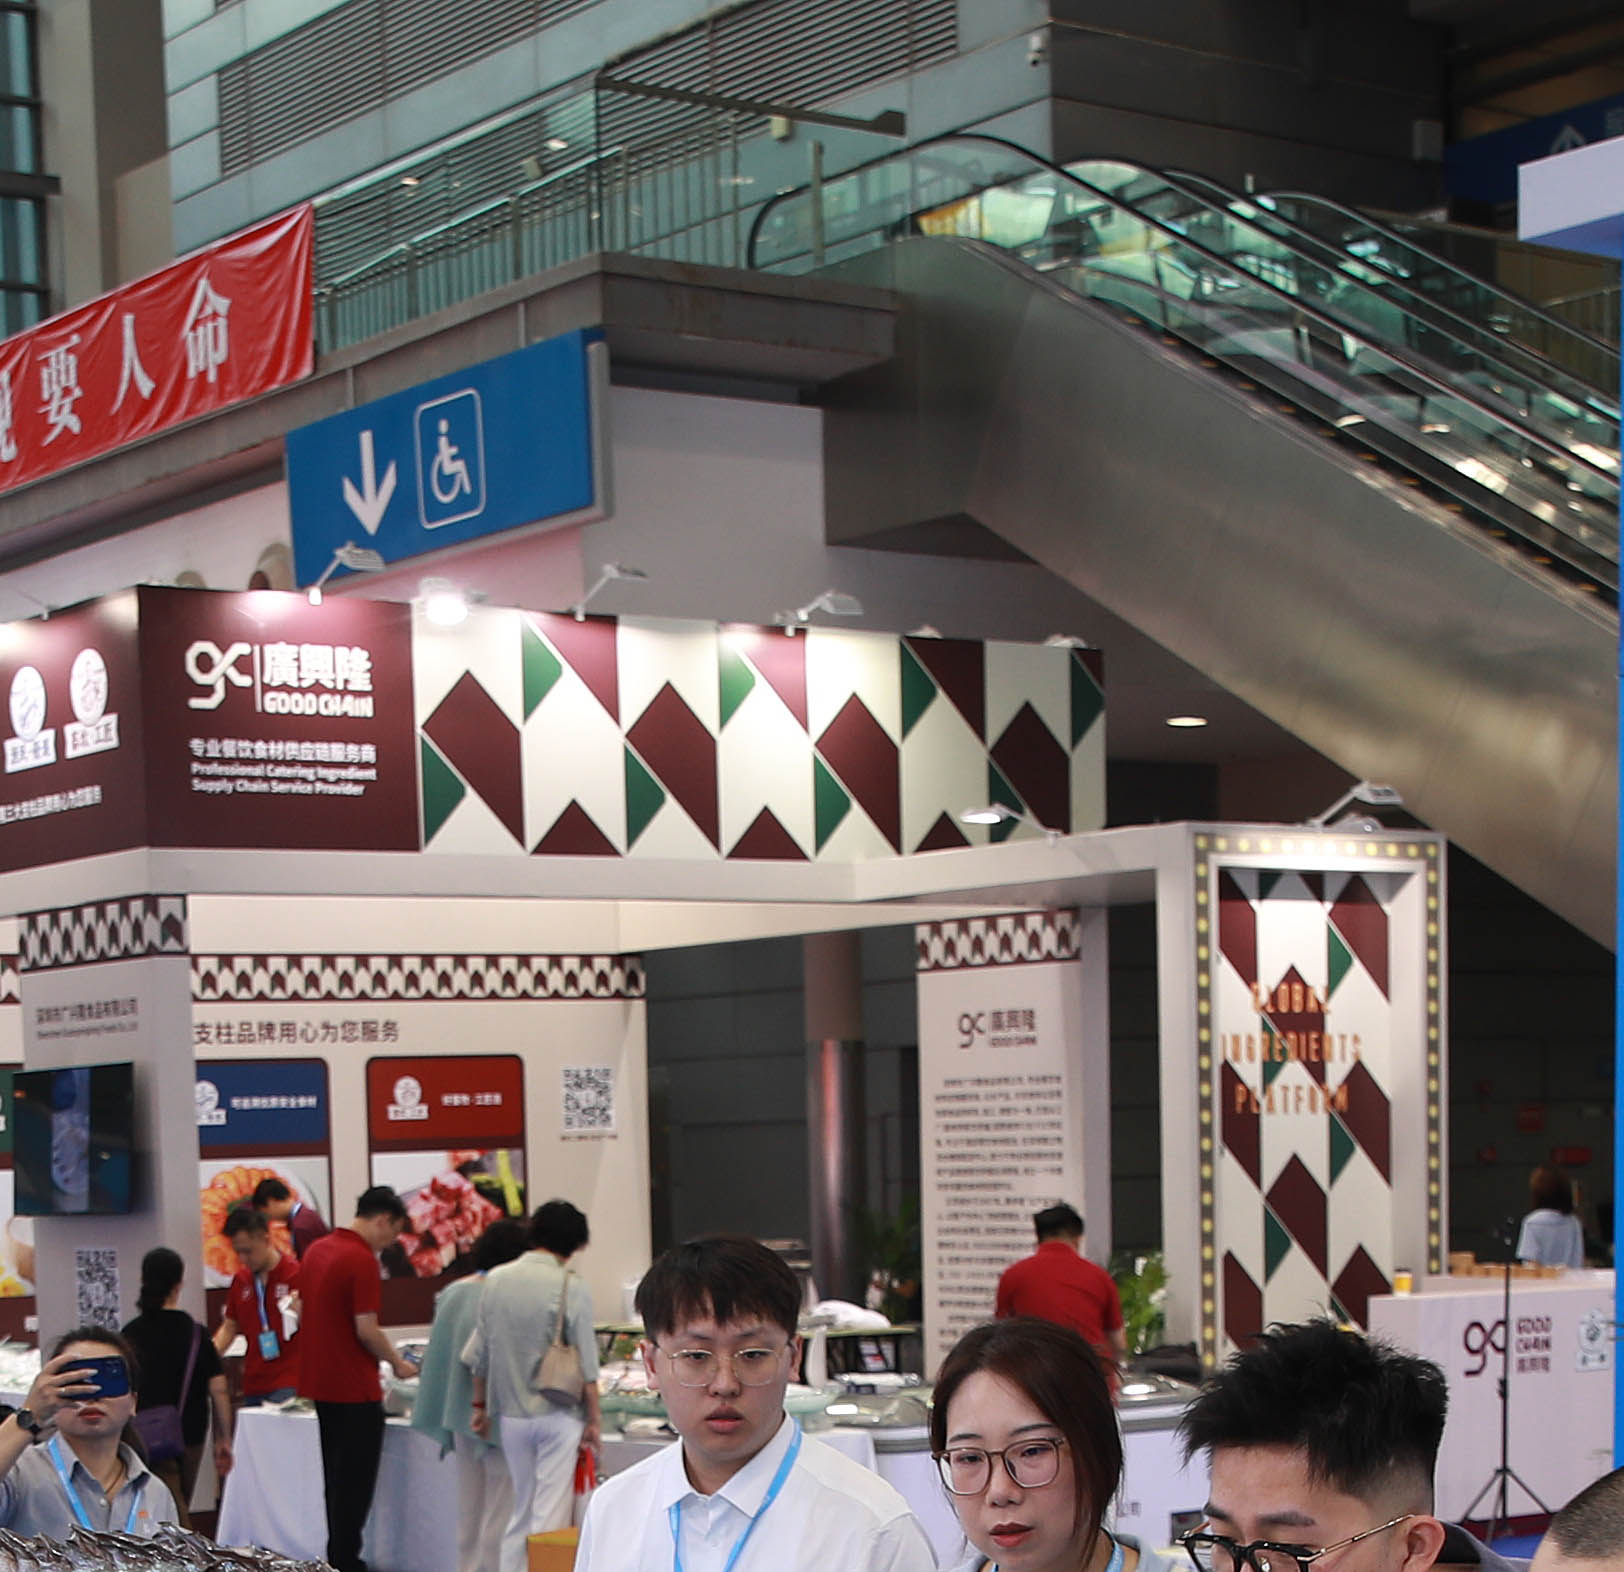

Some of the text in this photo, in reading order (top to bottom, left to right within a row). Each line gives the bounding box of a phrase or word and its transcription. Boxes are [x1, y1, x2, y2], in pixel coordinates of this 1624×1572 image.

[235, 780, 269, 793] Chain
[1251, 982, 1330, 1014] GLOBAL
[193, 1020, 400, 1045] 支柱品牌用心为您服务
[1221, 1032, 1361, 1062] INGREDIENTS
[1235, 1083, 1349, 1114] PLATFORM
